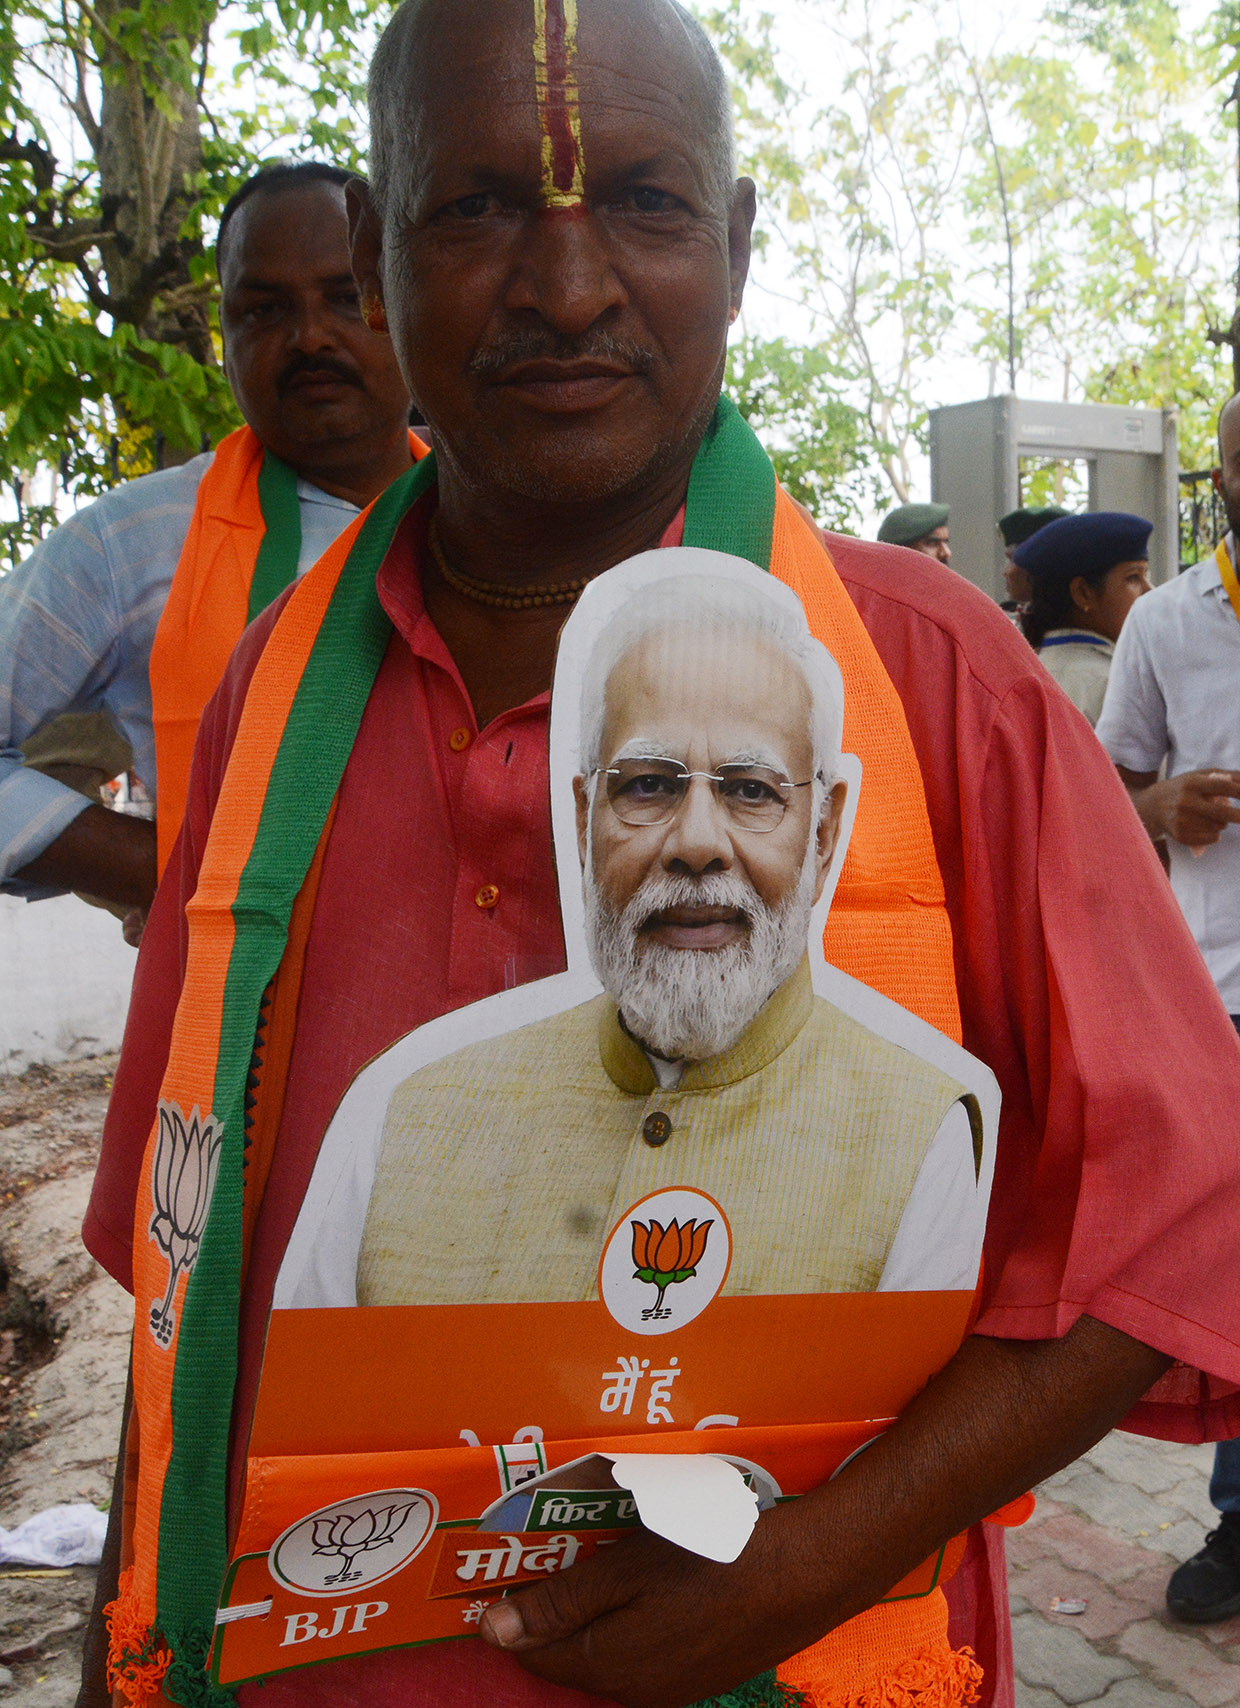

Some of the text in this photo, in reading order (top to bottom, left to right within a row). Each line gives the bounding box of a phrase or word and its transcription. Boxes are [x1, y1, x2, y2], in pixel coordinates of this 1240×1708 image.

[600, 1356, 681, 1424] मैं हूं
[538, 1497, 637, 1525] फिर ए
[455, 1534, 583, 1581] मोदी
[279, 1601, 389, 1647] BJP
